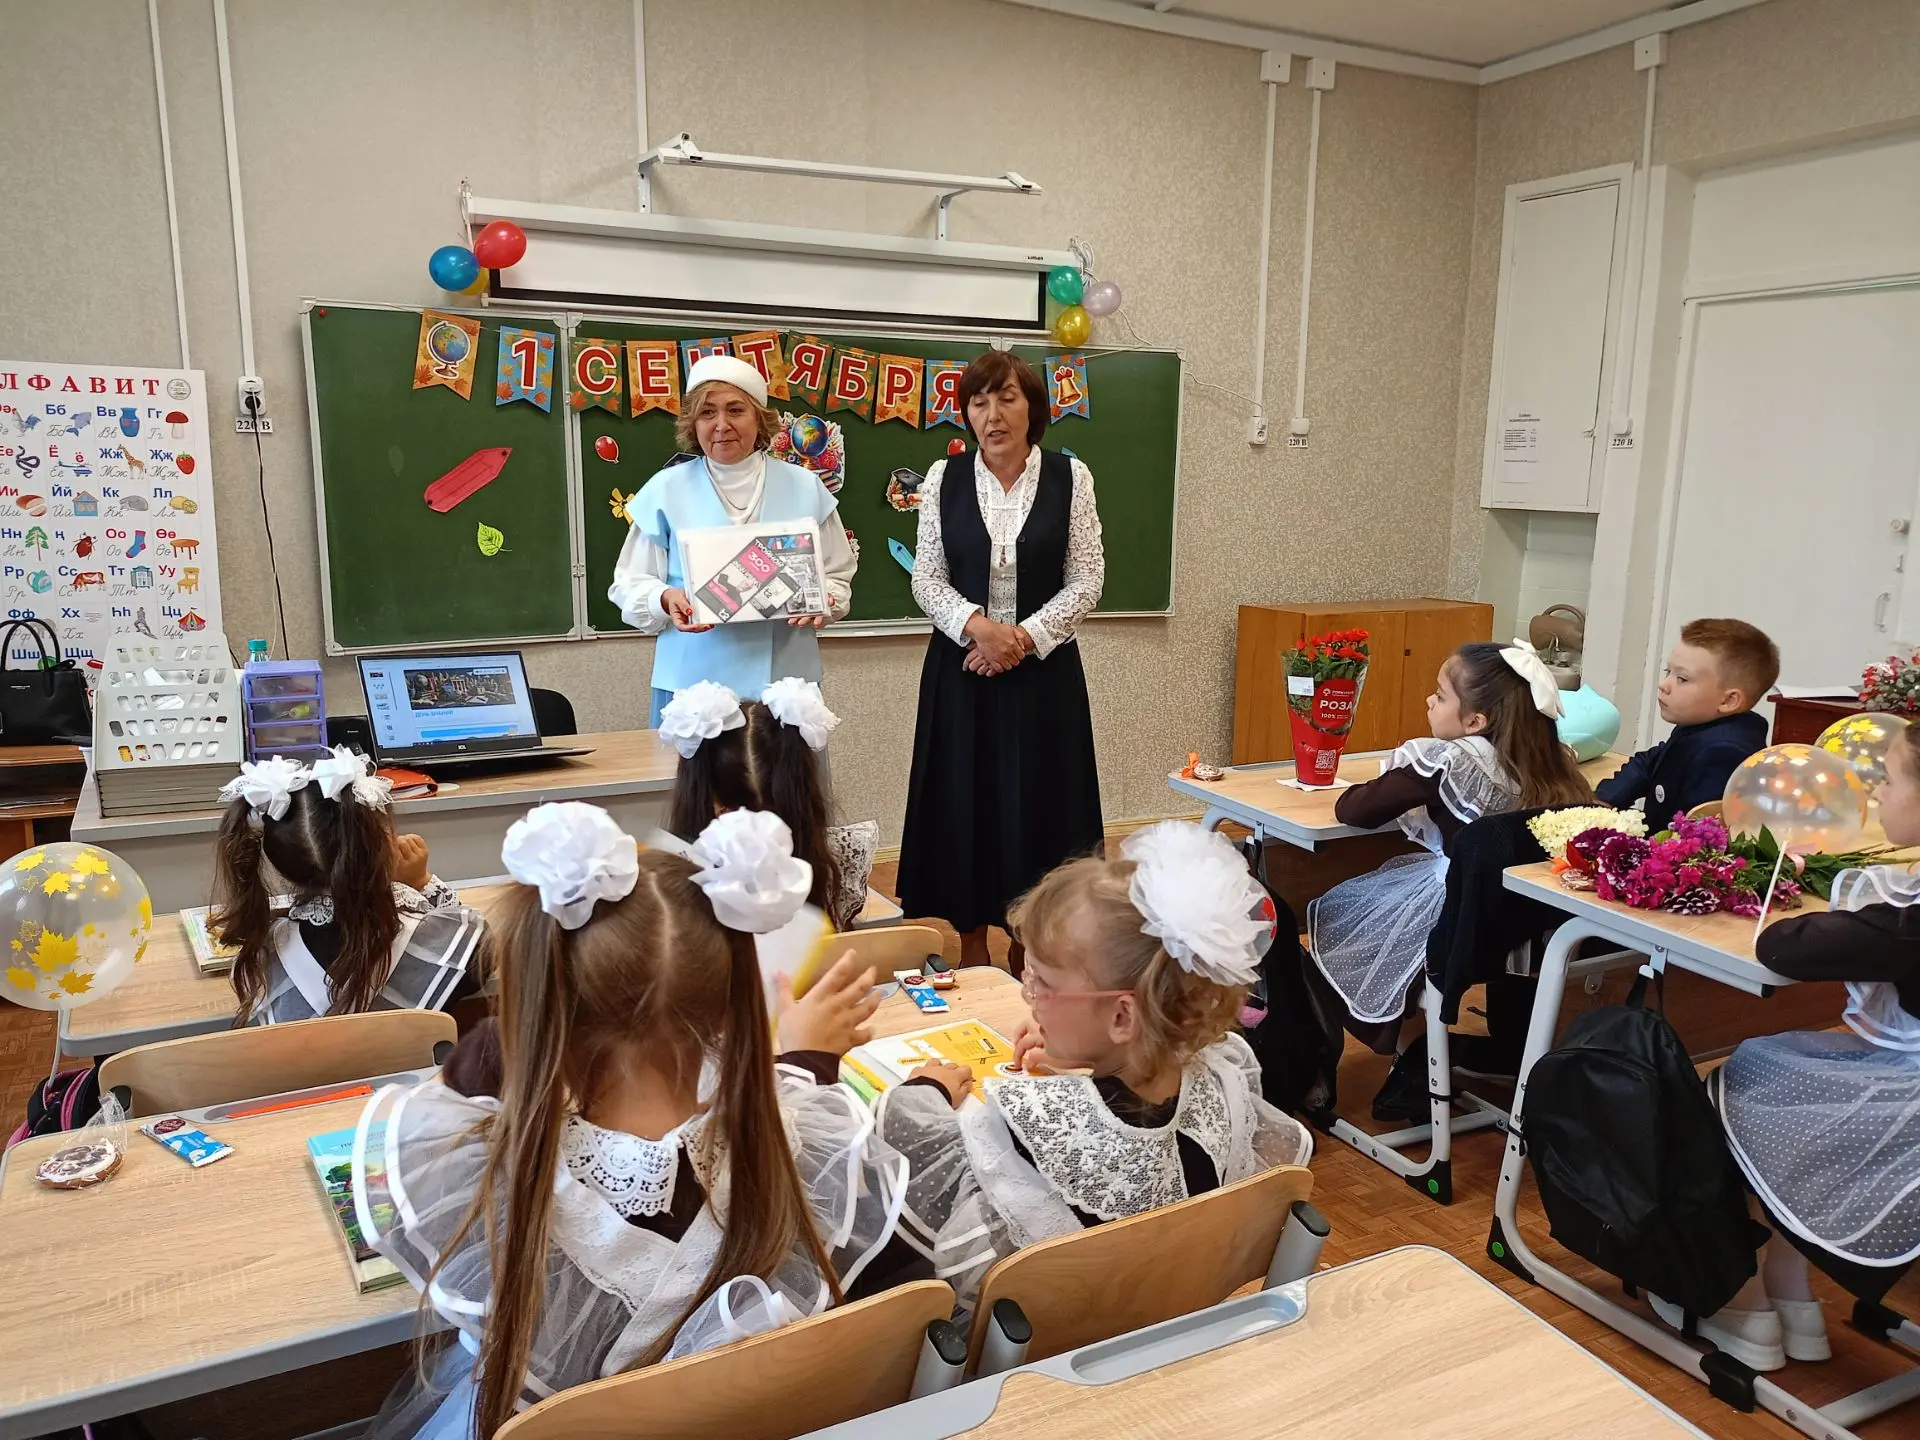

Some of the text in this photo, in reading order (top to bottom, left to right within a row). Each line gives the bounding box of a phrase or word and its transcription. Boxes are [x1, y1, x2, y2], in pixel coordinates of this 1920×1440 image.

[512, 338, 538, 389] 1
[46, 403, 66, 416] Бб
[97, 406, 117, 418] Вв
[148, 408, 162, 419] Гг
[1612, 439, 1625, 447] 220
[100, 449, 123, 460] Жж
[52, 484, 72, 498] Йй
[102, 487, 120, 499] Кк
[153, 488, 173, 499] Лл
[1, 528, 22, 539] Нн
[106, 528, 127, 539] Оо
[748, 551, 770, 573] 300
[4, 564, 175, 579] Рр Сс Тт Уу
[8, 608, 36, 620] Фф
[61, 607, 80, 619] Хх
[162, 606, 182, 619] Цц
[12, 647, 94, 660] Шш Щщ
[1320, 700, 1353, 710] РОЗА
